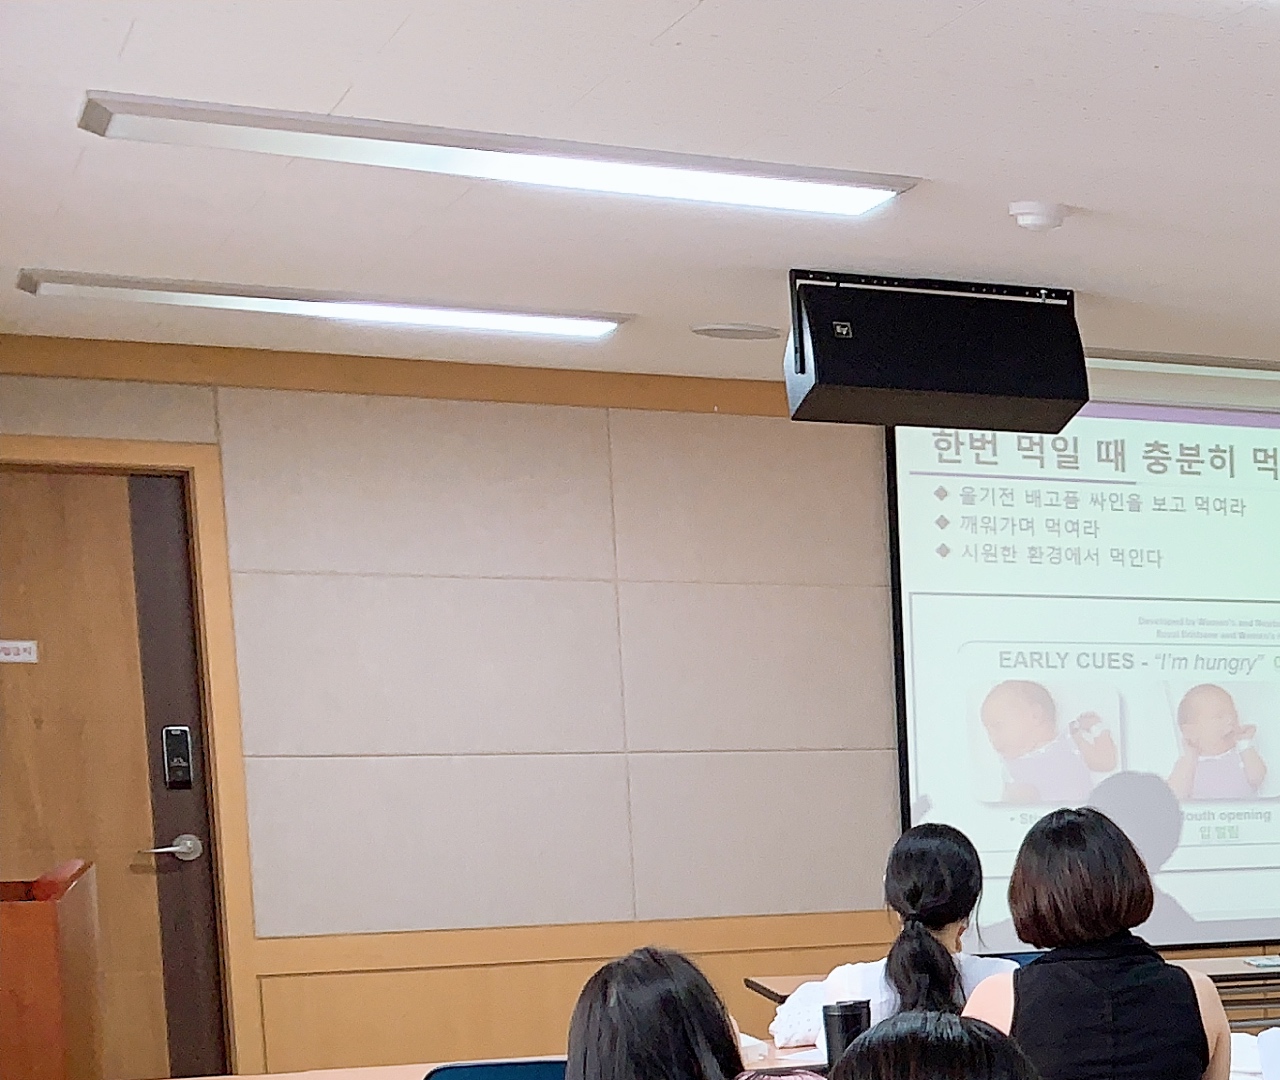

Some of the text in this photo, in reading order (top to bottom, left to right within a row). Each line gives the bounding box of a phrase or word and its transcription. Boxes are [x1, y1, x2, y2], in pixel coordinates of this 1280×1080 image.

[932, 430, 998, 465] 한번
[1017, 435, 1080, 470] 먹일
[1097, 439, 1127, 473] 때
[1142, 440, 1235, 478] 충분히
[1025, 489, 1081, 510] 배고픔
[1090, 492, 1142, 512] 싸인을
[1152, 496, 1187, 513] 보고
[1195, 496, 1247, 517] 먹여라
[960, 515, 1100, 539] 깨워가며 먹여라
[962, 543, 1163, 569] 시원한 환경에서 먹인다
[999, 651, 1069, 669] EARLY
[1077, 652, 1134, 670] CUES
[1219, 810, 1271, 823] opening
